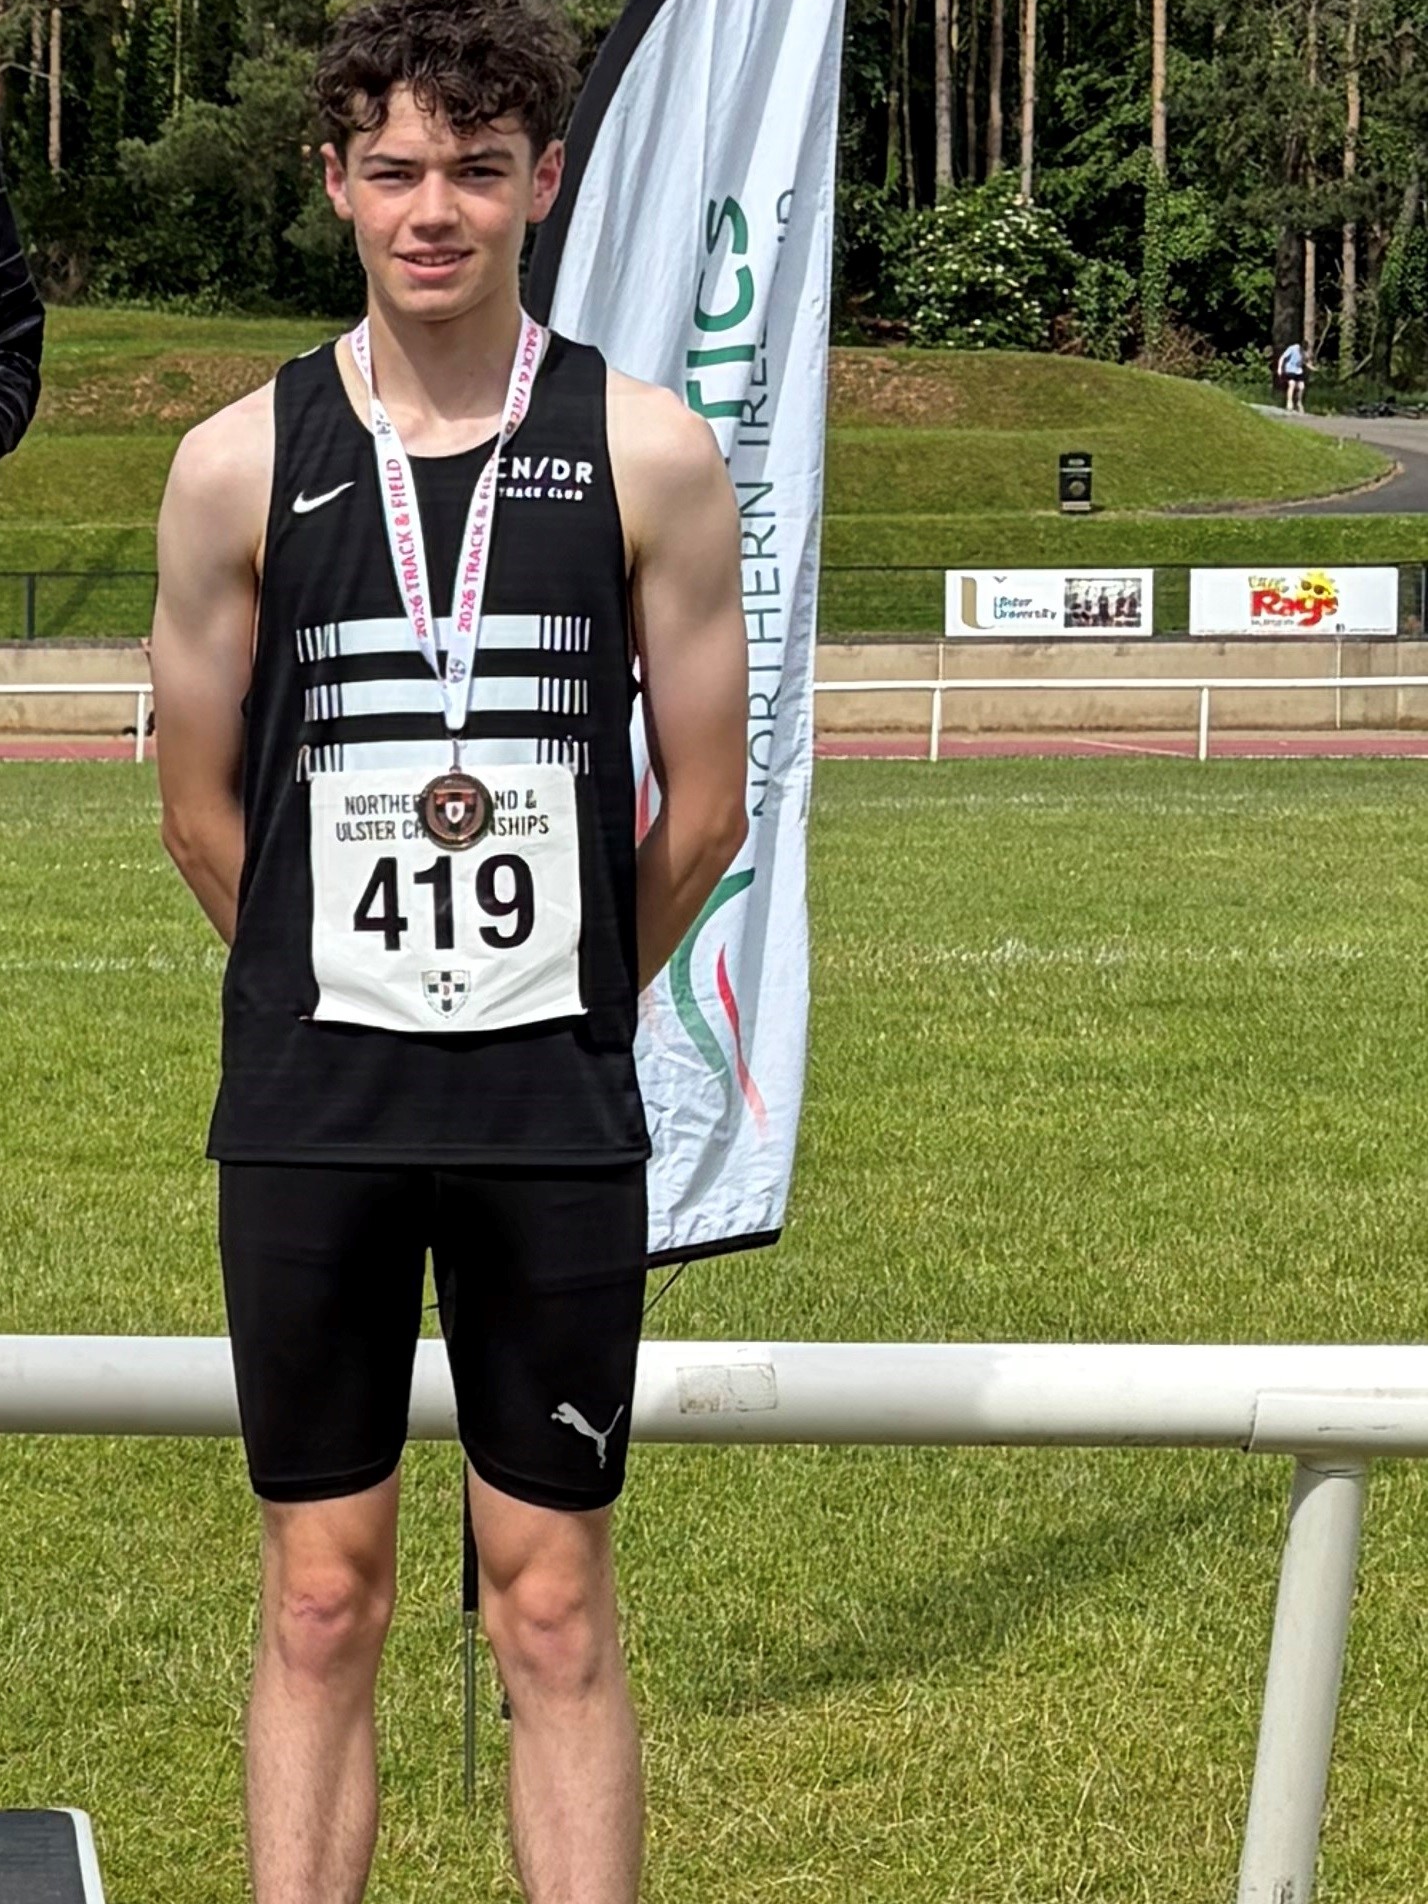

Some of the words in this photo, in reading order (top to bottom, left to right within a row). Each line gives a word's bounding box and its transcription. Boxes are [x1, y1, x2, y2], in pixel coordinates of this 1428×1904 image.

[385, 458, 409, 508] FIELD
[396, 530, 421, 594] TRACK
[464, 519, 486, 586] TRACK
[456, 587, 477, 634] 2026
[344, 793, 421, 816] NORTHER
[524, 789, 538, 810] &
[335, 820, 396, 842] ULSTER
[353, 853, 536, 952] 419
